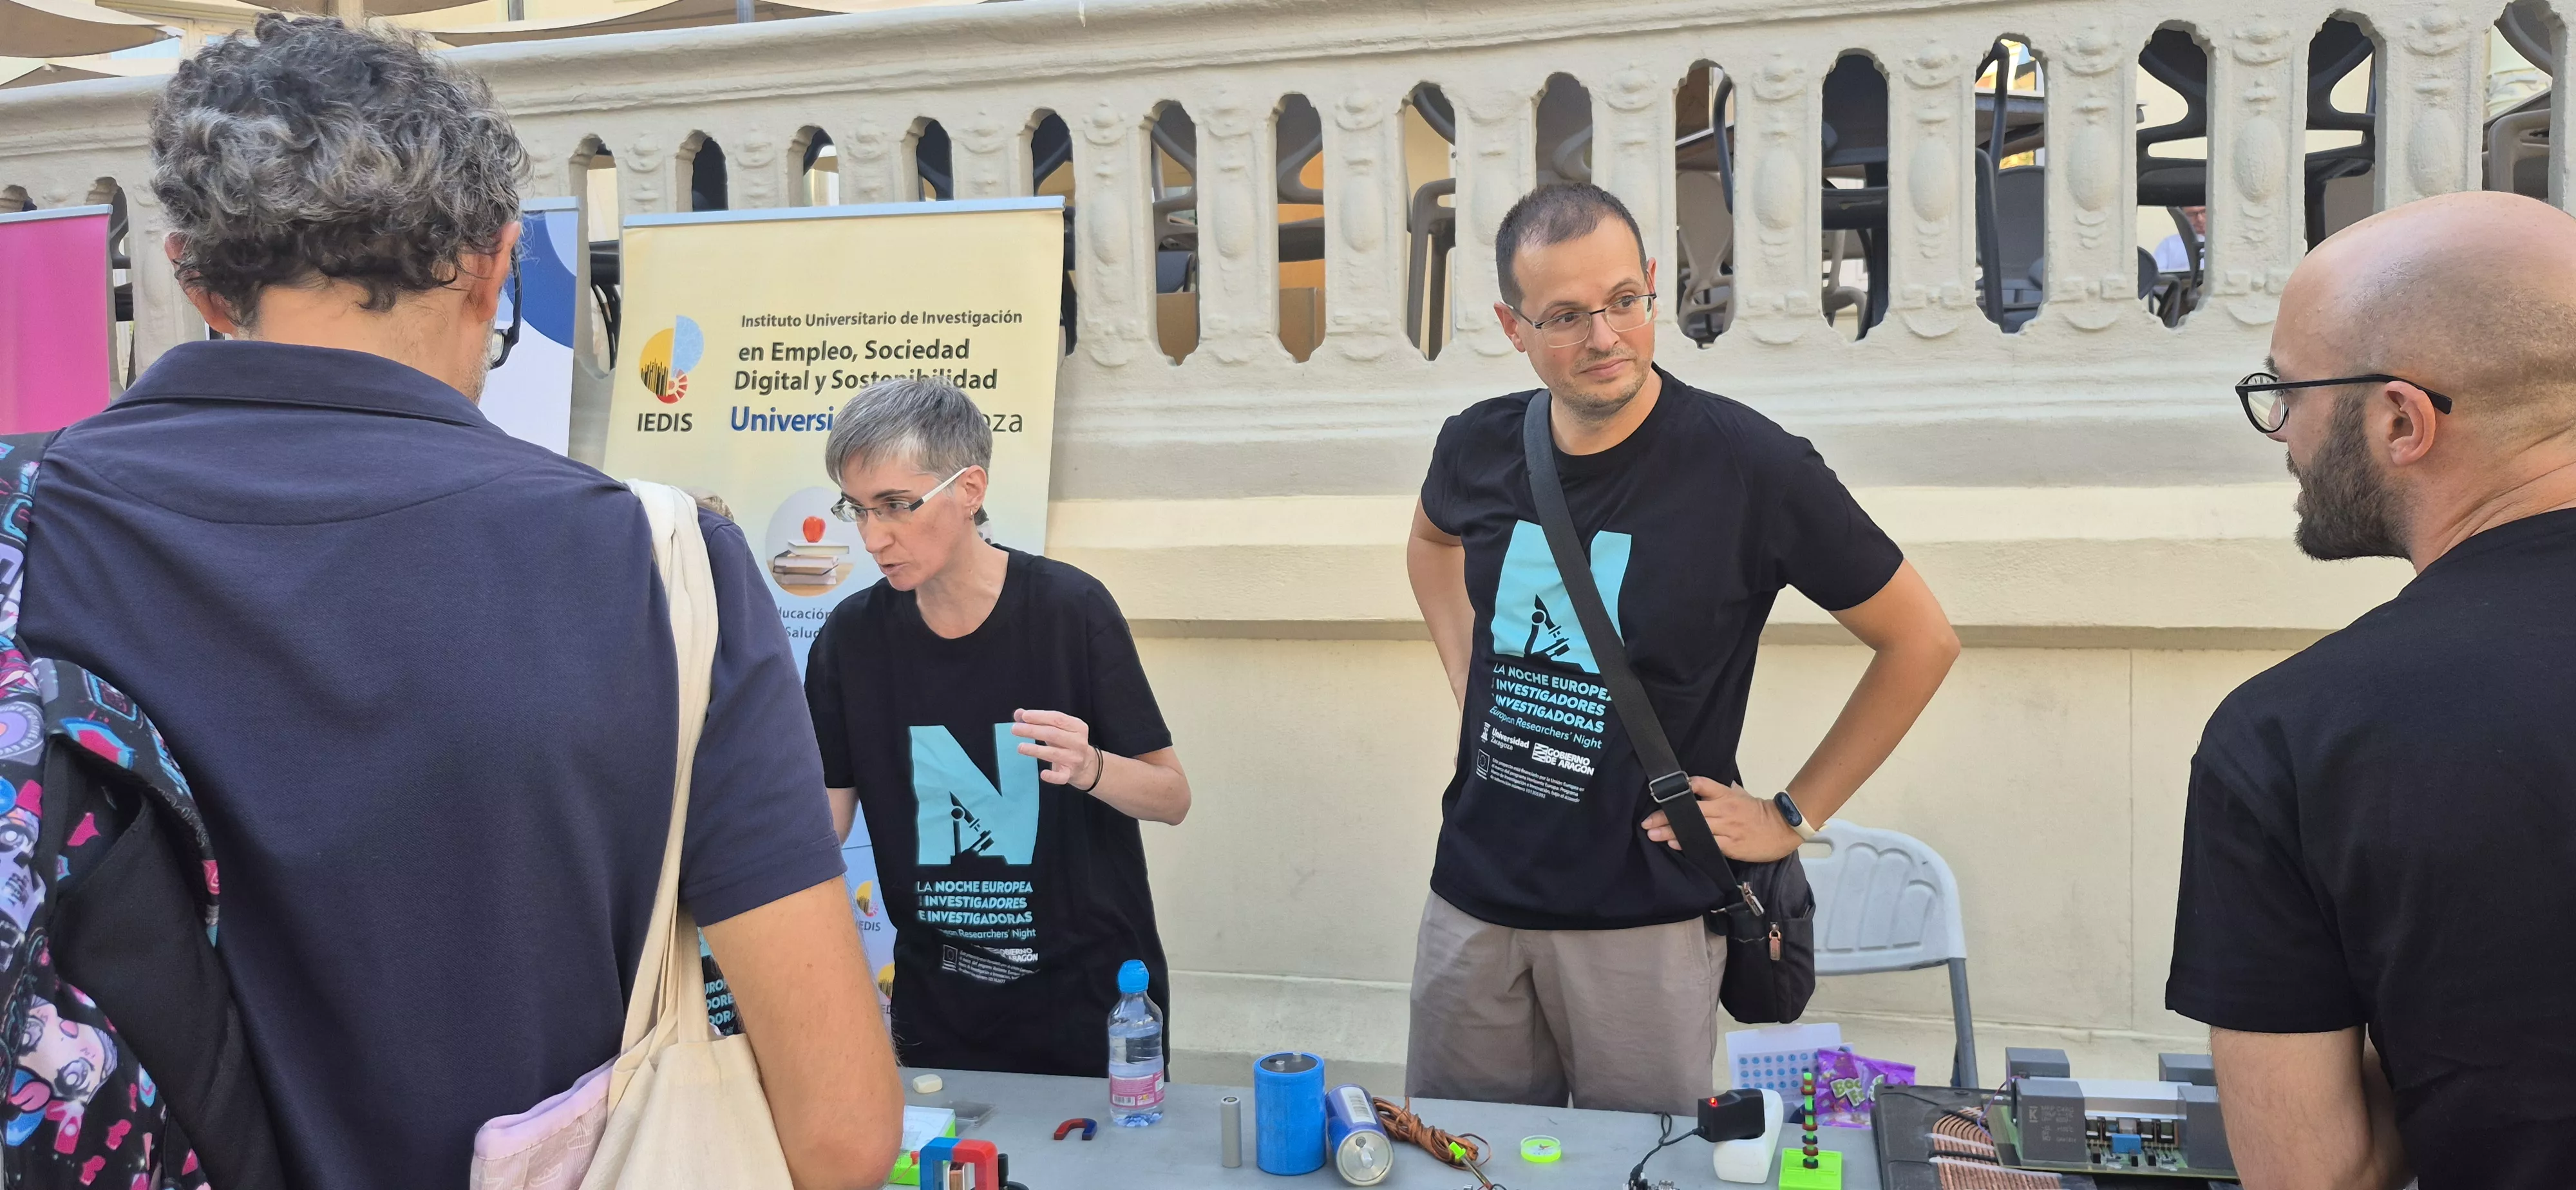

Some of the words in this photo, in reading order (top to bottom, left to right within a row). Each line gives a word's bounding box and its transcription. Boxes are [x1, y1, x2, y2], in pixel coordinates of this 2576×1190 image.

[741, 314, 802, 328] Instituto
[806, 312, 897, 327] Universitario
[900, 311, 919, 325] de
[923, 310, 1023, 327] Investigación
[739, 346, 764, 361] en
[772, 340, 858, 366] Empleo,
[865, 338, 970, 359] Sociedad
[735, 370, 810, 395] Digital
[815, 375, 828, 396] y
[637, 413, 693, 432] IEDIS
[731, 406, 835, 432] Universi
[1493, 662, 1506, 675] LA
[1508, 666, 1549, 686] NOCHE
[1496, 678, 1606, 716] INVESTIGADORES
[1495, 694, 1605, 733] INVESTIGADORAS
[1490, 736, 1513, 751] Zaragoza
[1492, 727, 1530, 749] Universidad
[1573, 733, 1602, 749] Night
[1546, 755, 1557, 766] DE
[1558, 760, 1595, 776] ARAGON
[1548, 748, 1591, 766] GOBIERNO
[917, 880, 933, 892] LA
[935, 880, 980, 892] NOCHE
[982, 880, 1034, 894] EUROPEA
[925, 895, 1028, 909] INVESTIGADORES
[927, 911, 1033, 925] INVESTIGADORAS
[1011, 927, 1036, 940] Night
